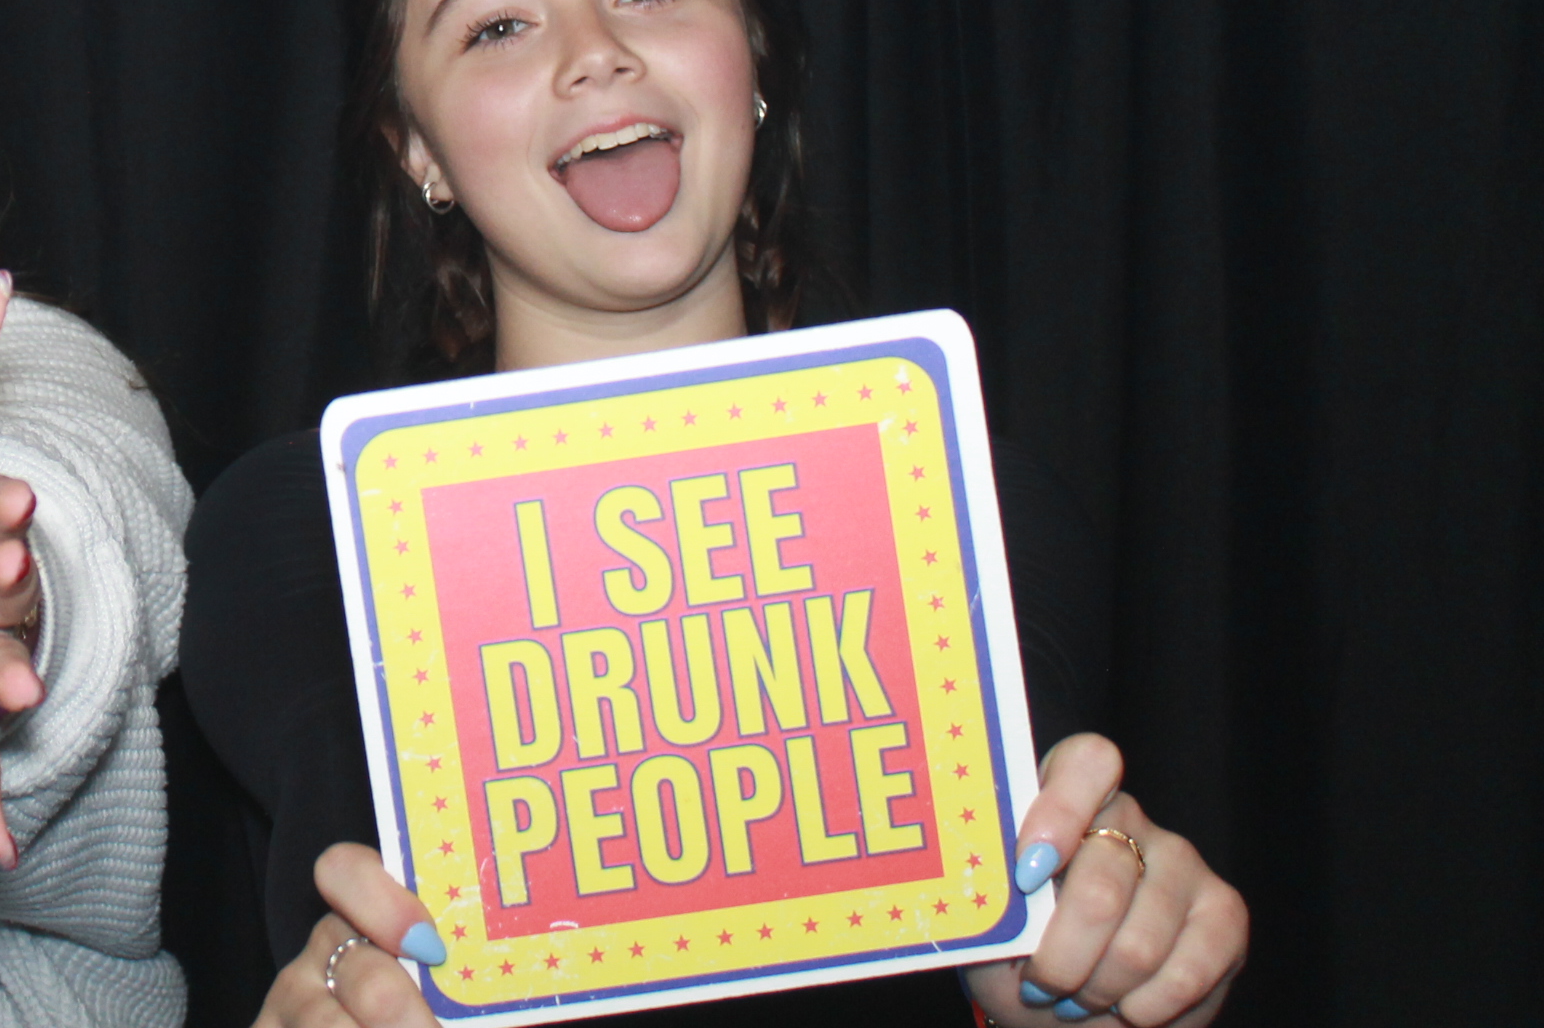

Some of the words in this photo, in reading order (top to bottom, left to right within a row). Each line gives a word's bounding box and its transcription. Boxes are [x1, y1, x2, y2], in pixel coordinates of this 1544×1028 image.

[514, 499, 562, 630] I
[593, 462, 815, 616] SEE
[479, 588, 896, 772] DRUNK
[483, 722, 926, 909] PEOPLE
